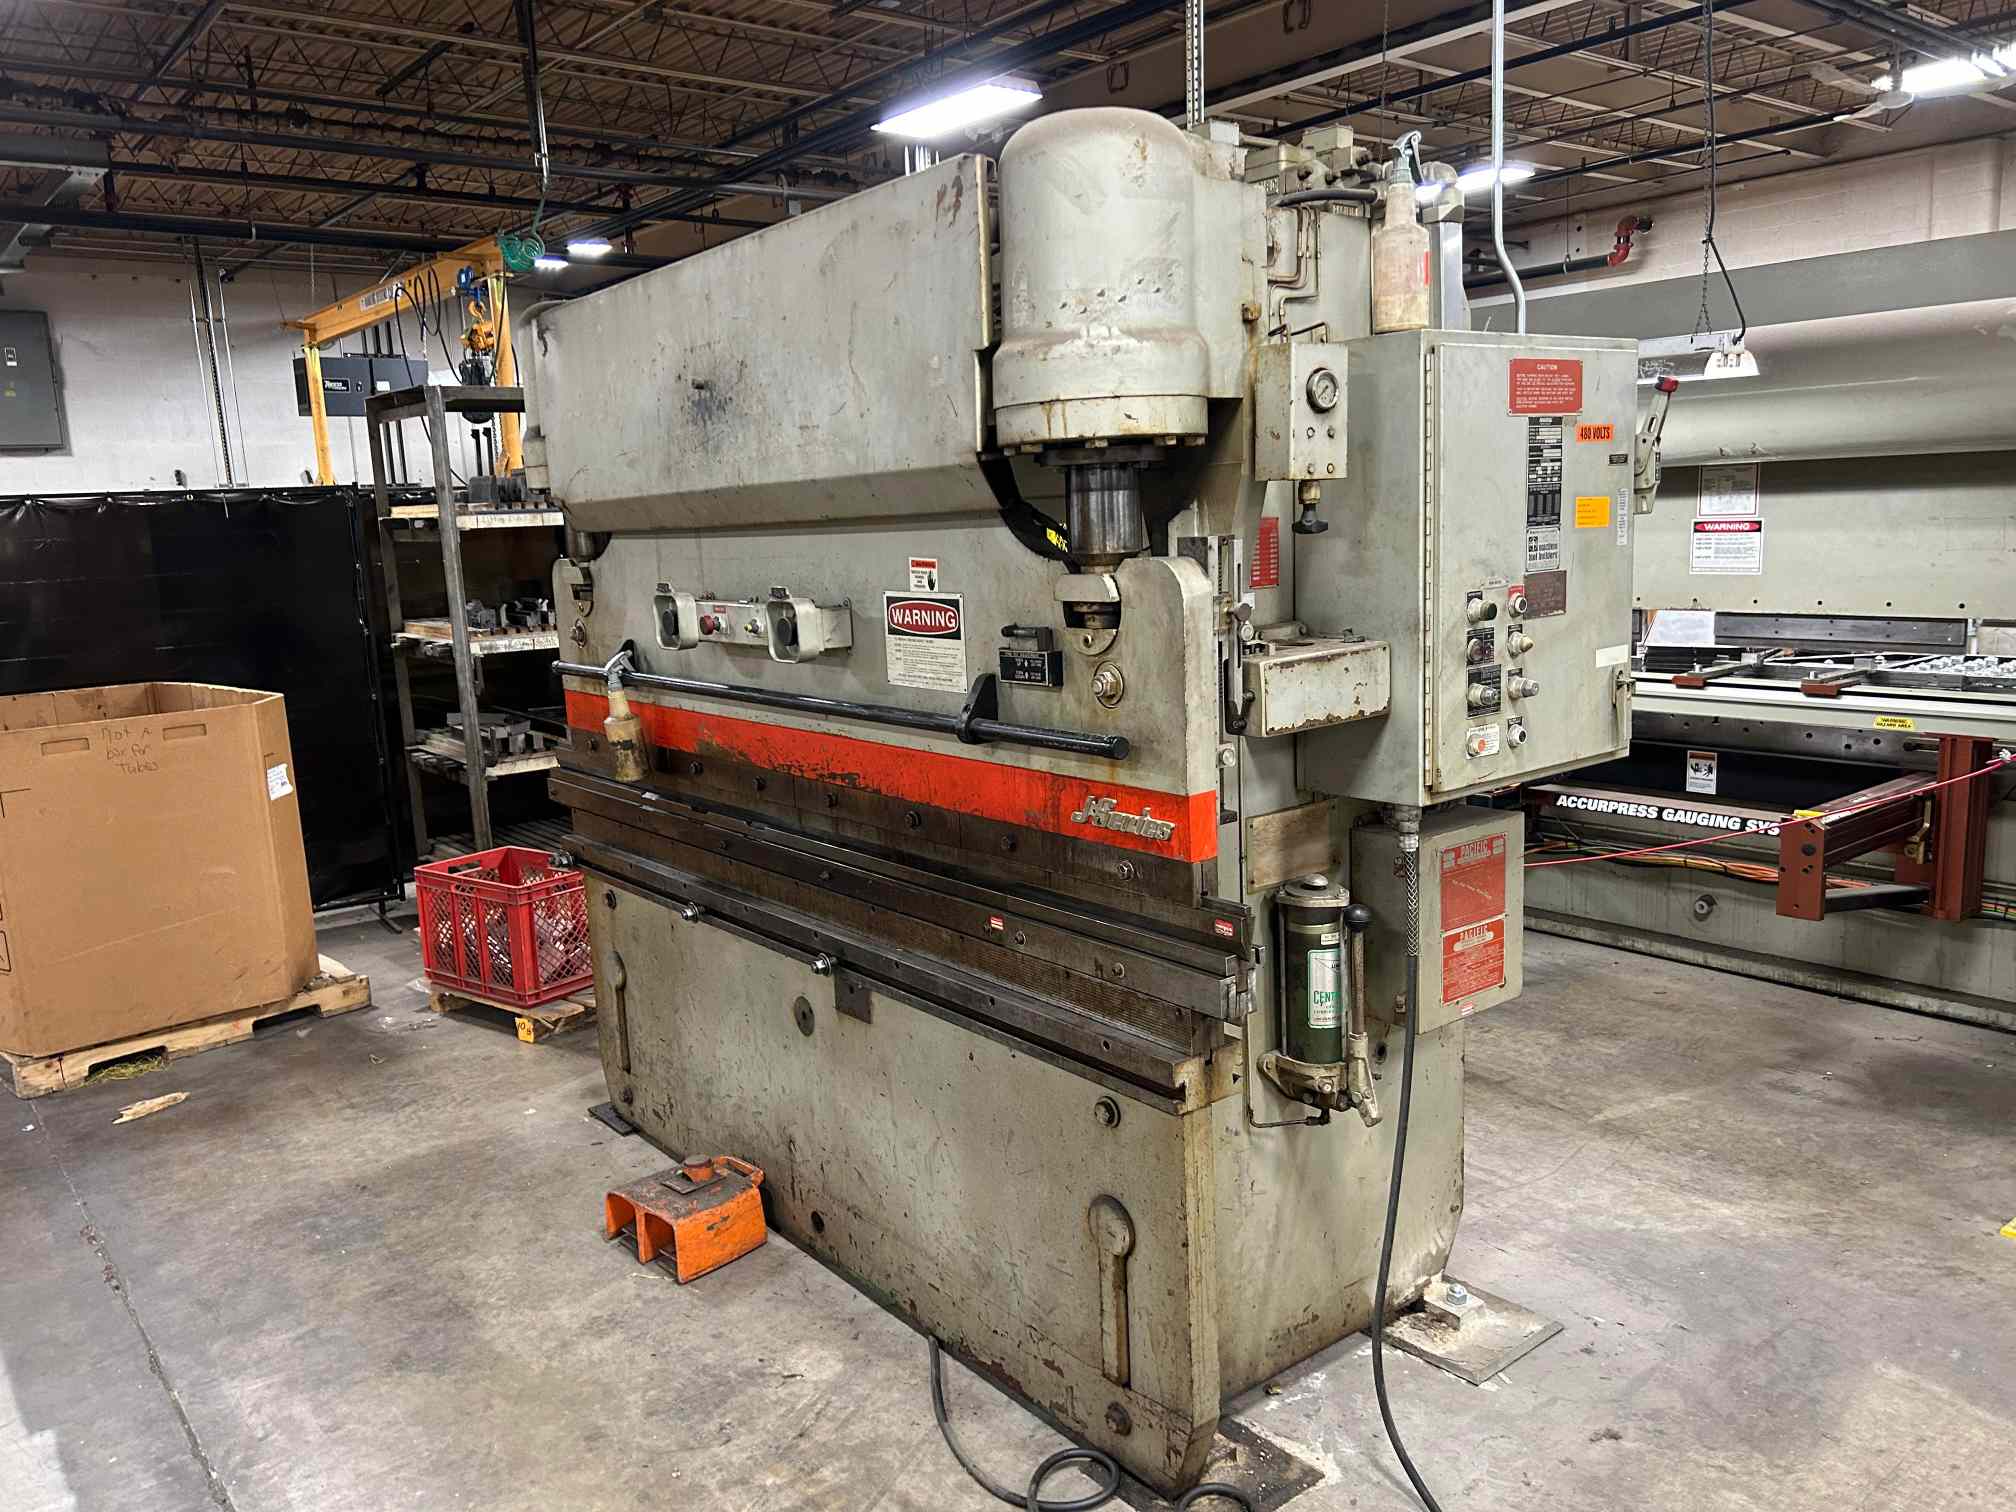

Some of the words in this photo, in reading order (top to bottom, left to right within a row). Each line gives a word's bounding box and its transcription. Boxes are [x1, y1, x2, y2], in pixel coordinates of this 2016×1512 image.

[1580, 426, 1592, 440] 480
[1592, 425, 1611, 440] VOLTS
[1703, 522, 1751, 531] WARNING
[891, 607, 957, 628] WARNING
[1556, 795, 1658, 819] ACCURPRESS
[1662, 807, 1741, 831] GAUGING
[1745, 818, 1781, 836] SYS
[1459, 924, 1489, 942] PACIFIC
